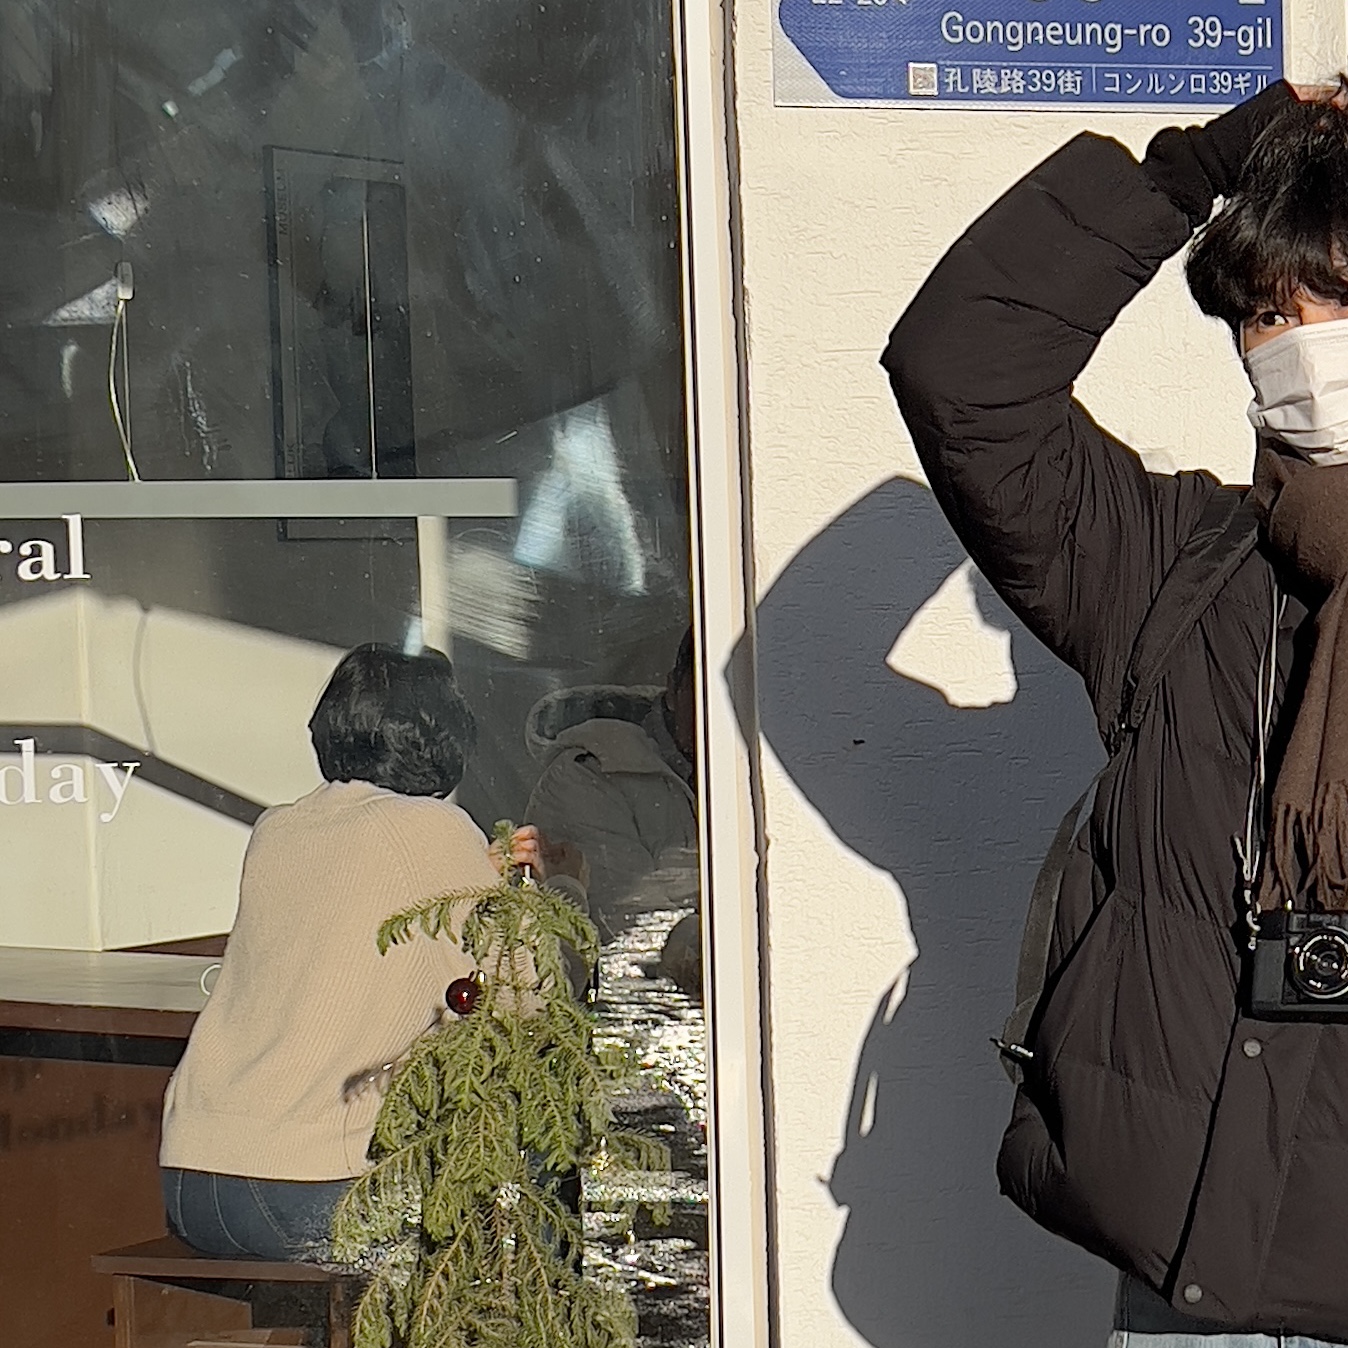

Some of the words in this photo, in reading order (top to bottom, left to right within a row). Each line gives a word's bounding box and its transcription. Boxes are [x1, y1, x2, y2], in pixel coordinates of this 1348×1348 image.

[940, 11, 1171, 54] Gongneung-ro
[1187, 16, 1272, 55] 39-gil
[944, 67, 1083, 95] 孔陵路39街
[1103, 70, 1268, 95] コンルンロ39ギル
